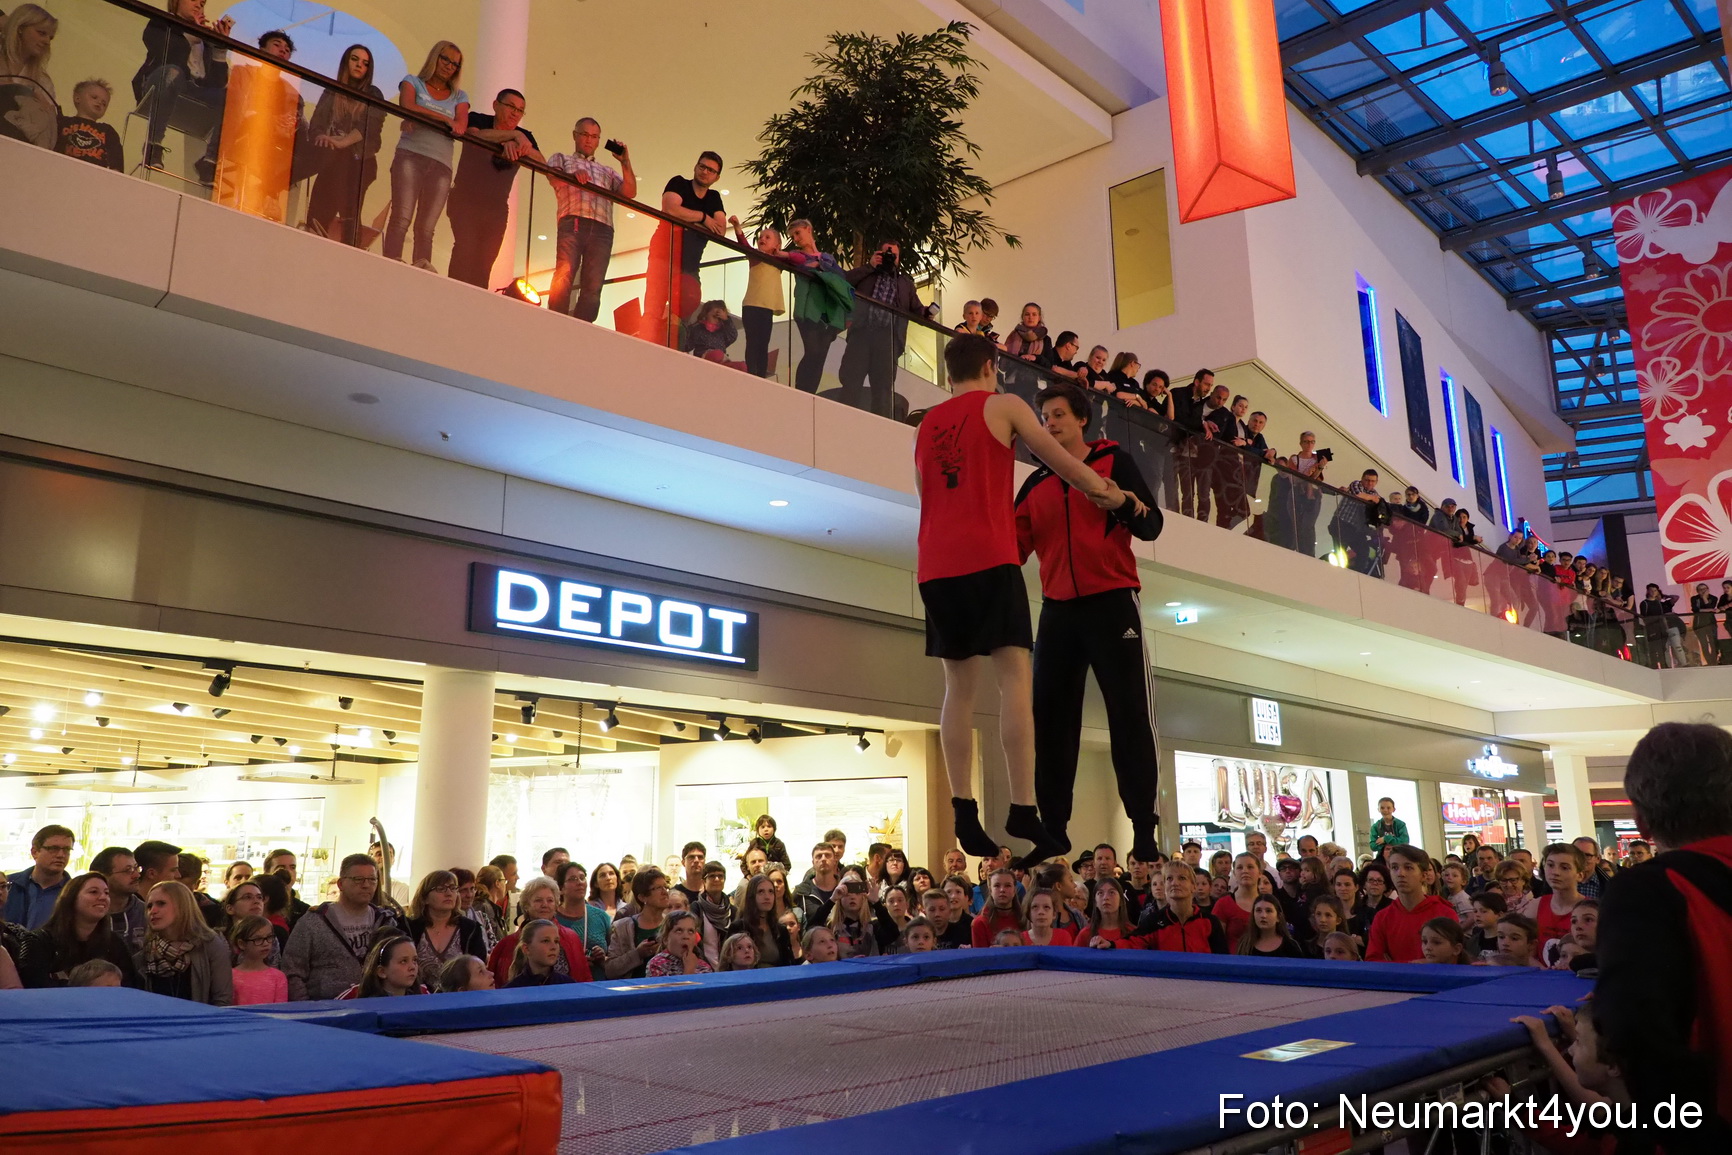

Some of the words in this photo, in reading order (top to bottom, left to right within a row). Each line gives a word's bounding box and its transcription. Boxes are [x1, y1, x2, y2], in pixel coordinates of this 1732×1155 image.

[496, 569, 748, 654] DEPOT
[1256, 701, 1277, 720] LUISA
[1257, 722, 1280, 741] LUISA
[1447, 803, 1495, 821] Hervis
